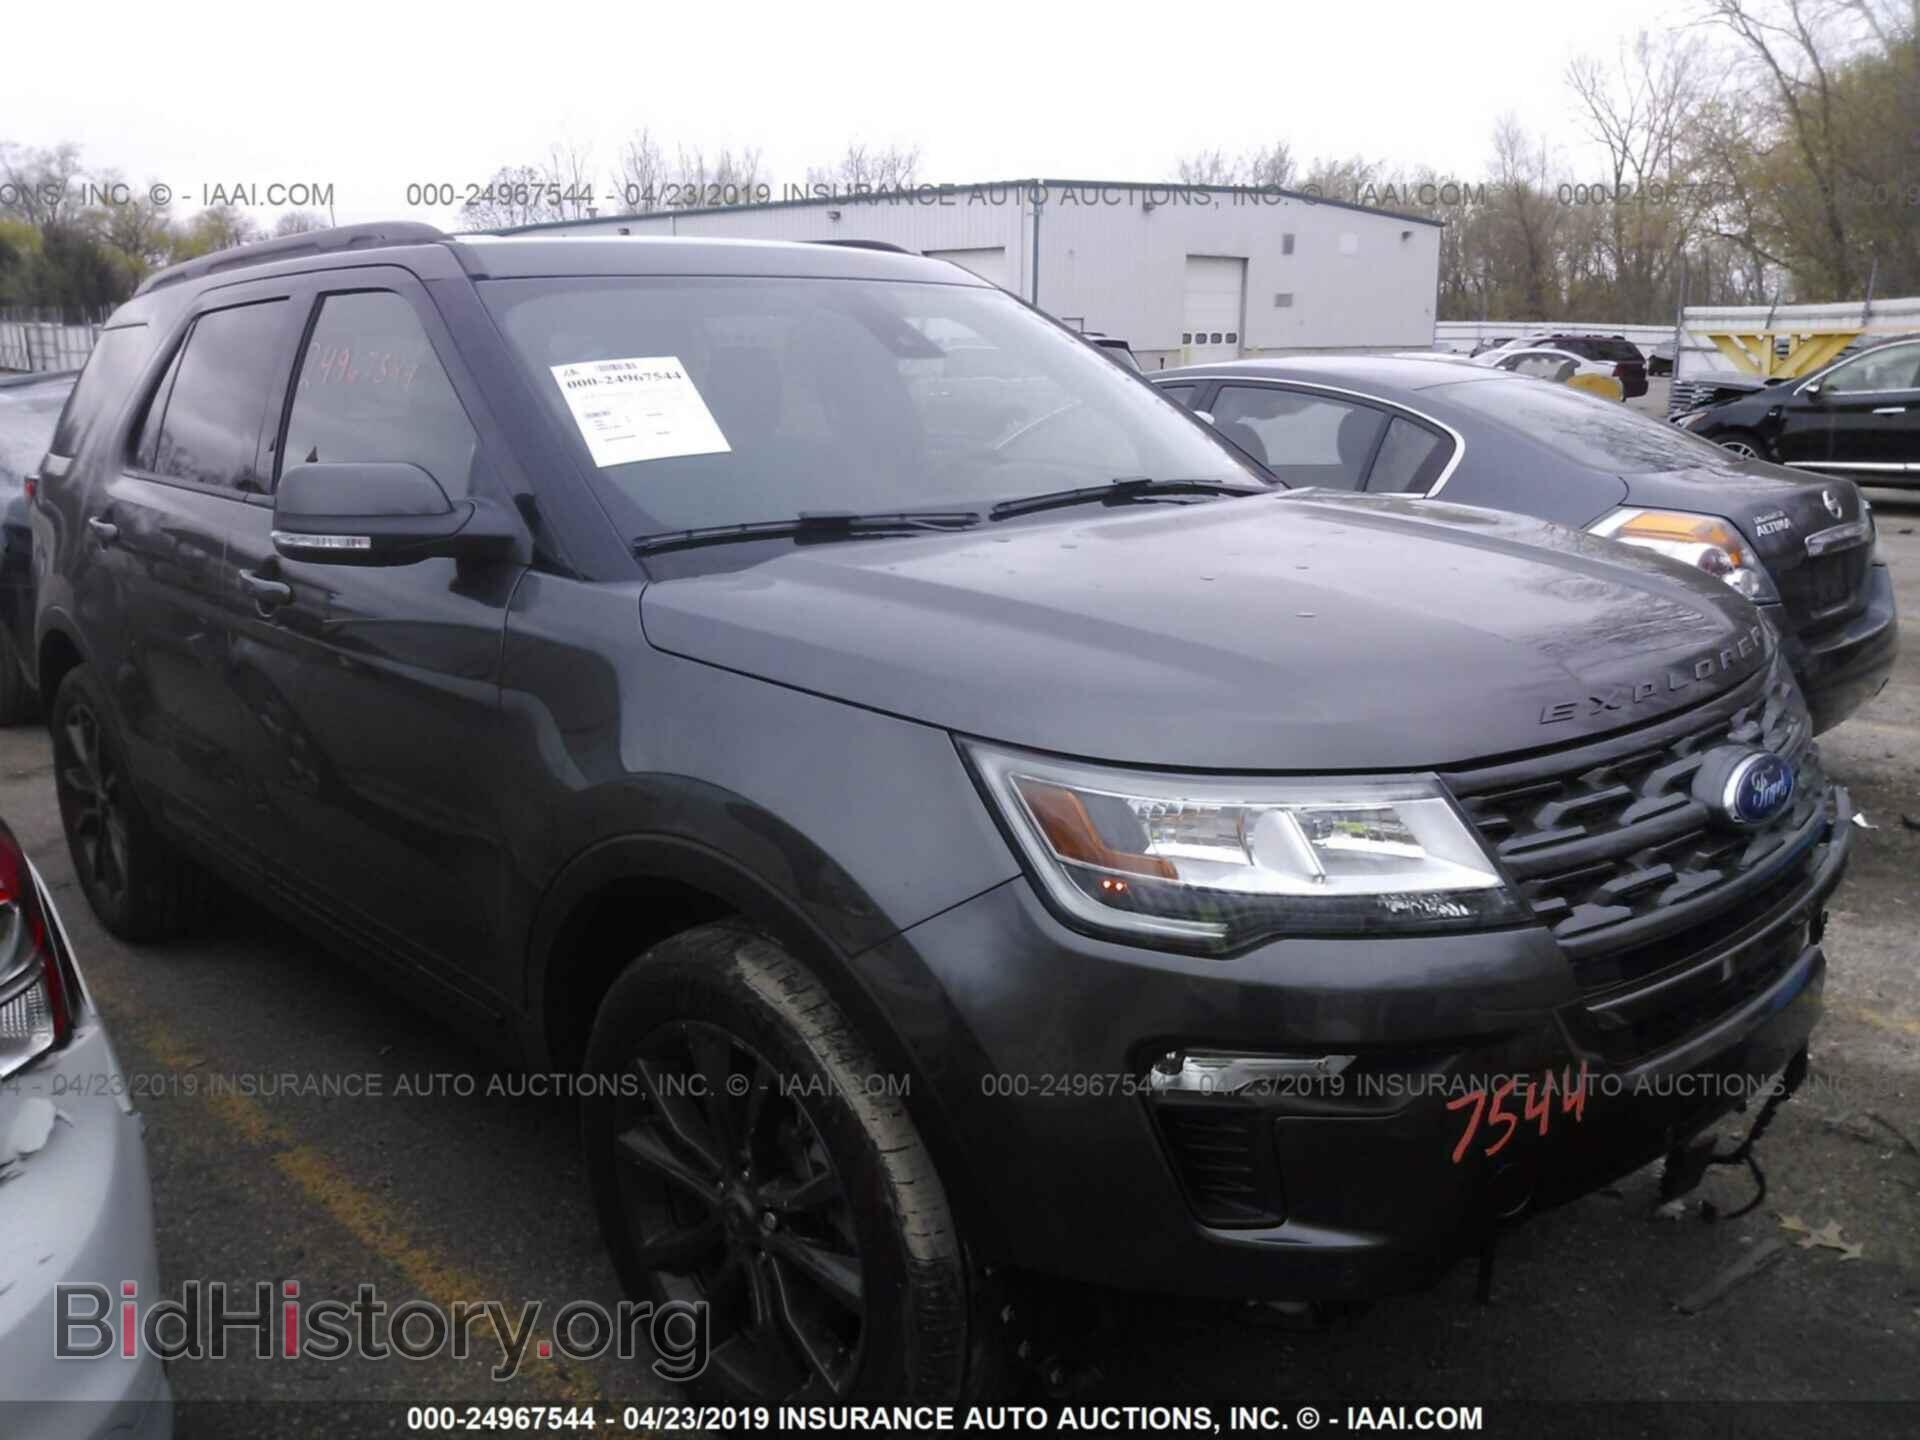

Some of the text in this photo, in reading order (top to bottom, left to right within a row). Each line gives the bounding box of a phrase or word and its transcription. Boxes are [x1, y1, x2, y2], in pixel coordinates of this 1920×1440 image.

[567, 370, 682, 389] 000-24967544
[1751, 769, 1787, 808] Ford
[1446, 1059, 1588, 1163] 7544
